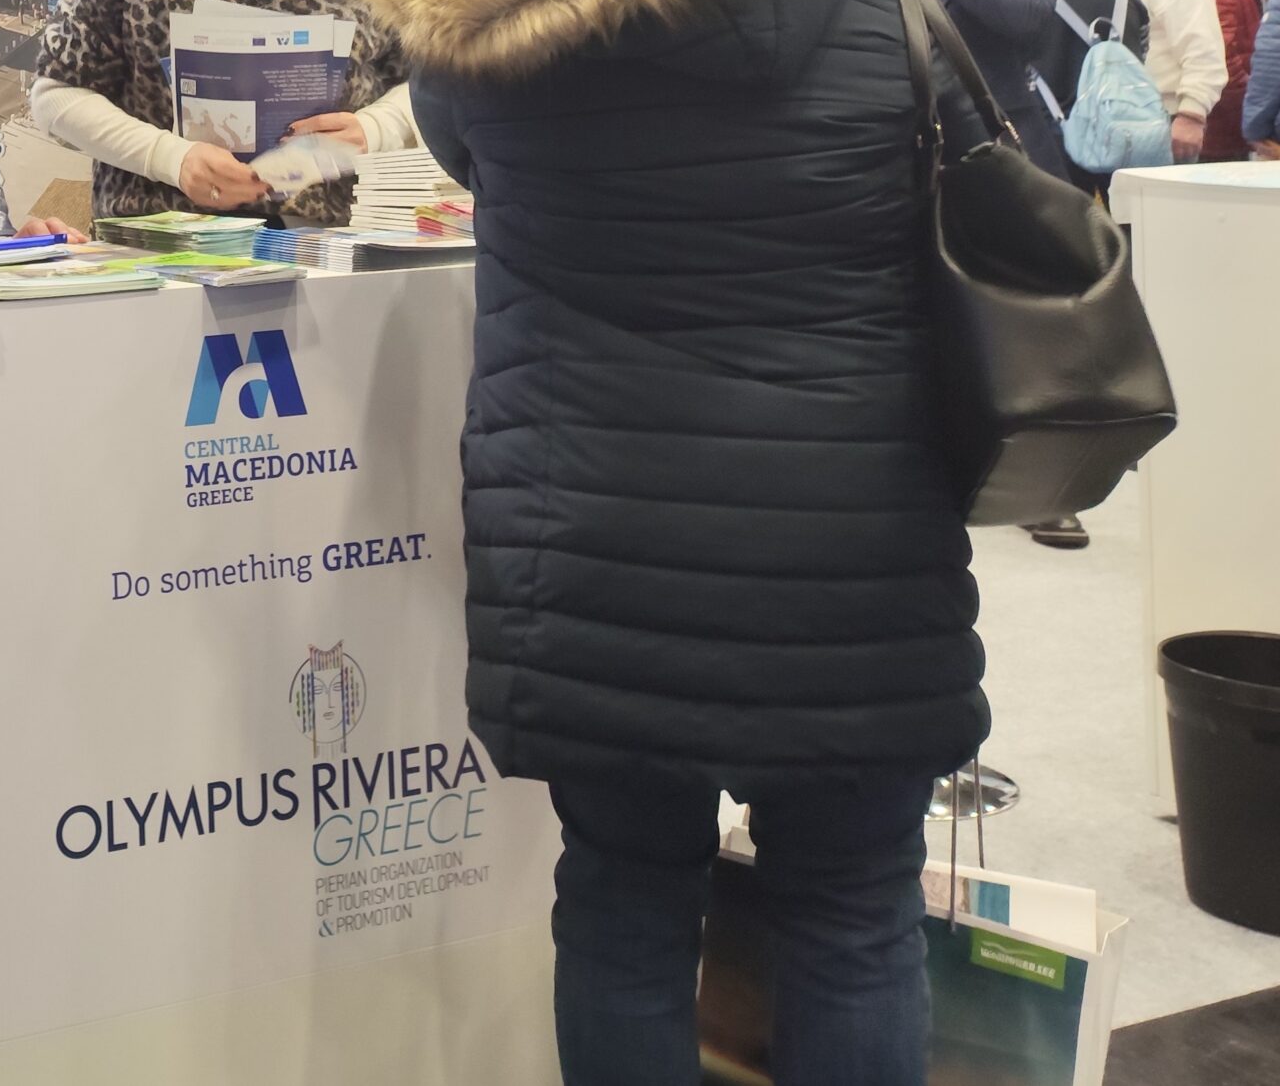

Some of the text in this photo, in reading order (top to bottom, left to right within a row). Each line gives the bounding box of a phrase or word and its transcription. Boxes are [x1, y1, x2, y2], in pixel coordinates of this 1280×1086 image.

[184, 434, 280, 459] CENTRAL
[185, 447, 358, 488] MACEDONIA
[186, 486, 254, 508] GREECE
[112, 533, 432, 600] Do something GREAT.
[55, 738, 487, 860] OLYMPUS RIVIERA
[313, 788, 487, 866] GREECE
[316, 851, 464, 895] PIERIAN ORGANIZATION
[316, 865, 490, 917] OF TOURISM DEVELOPMENT
[318, 903, 412, 937] & PROMOTION
